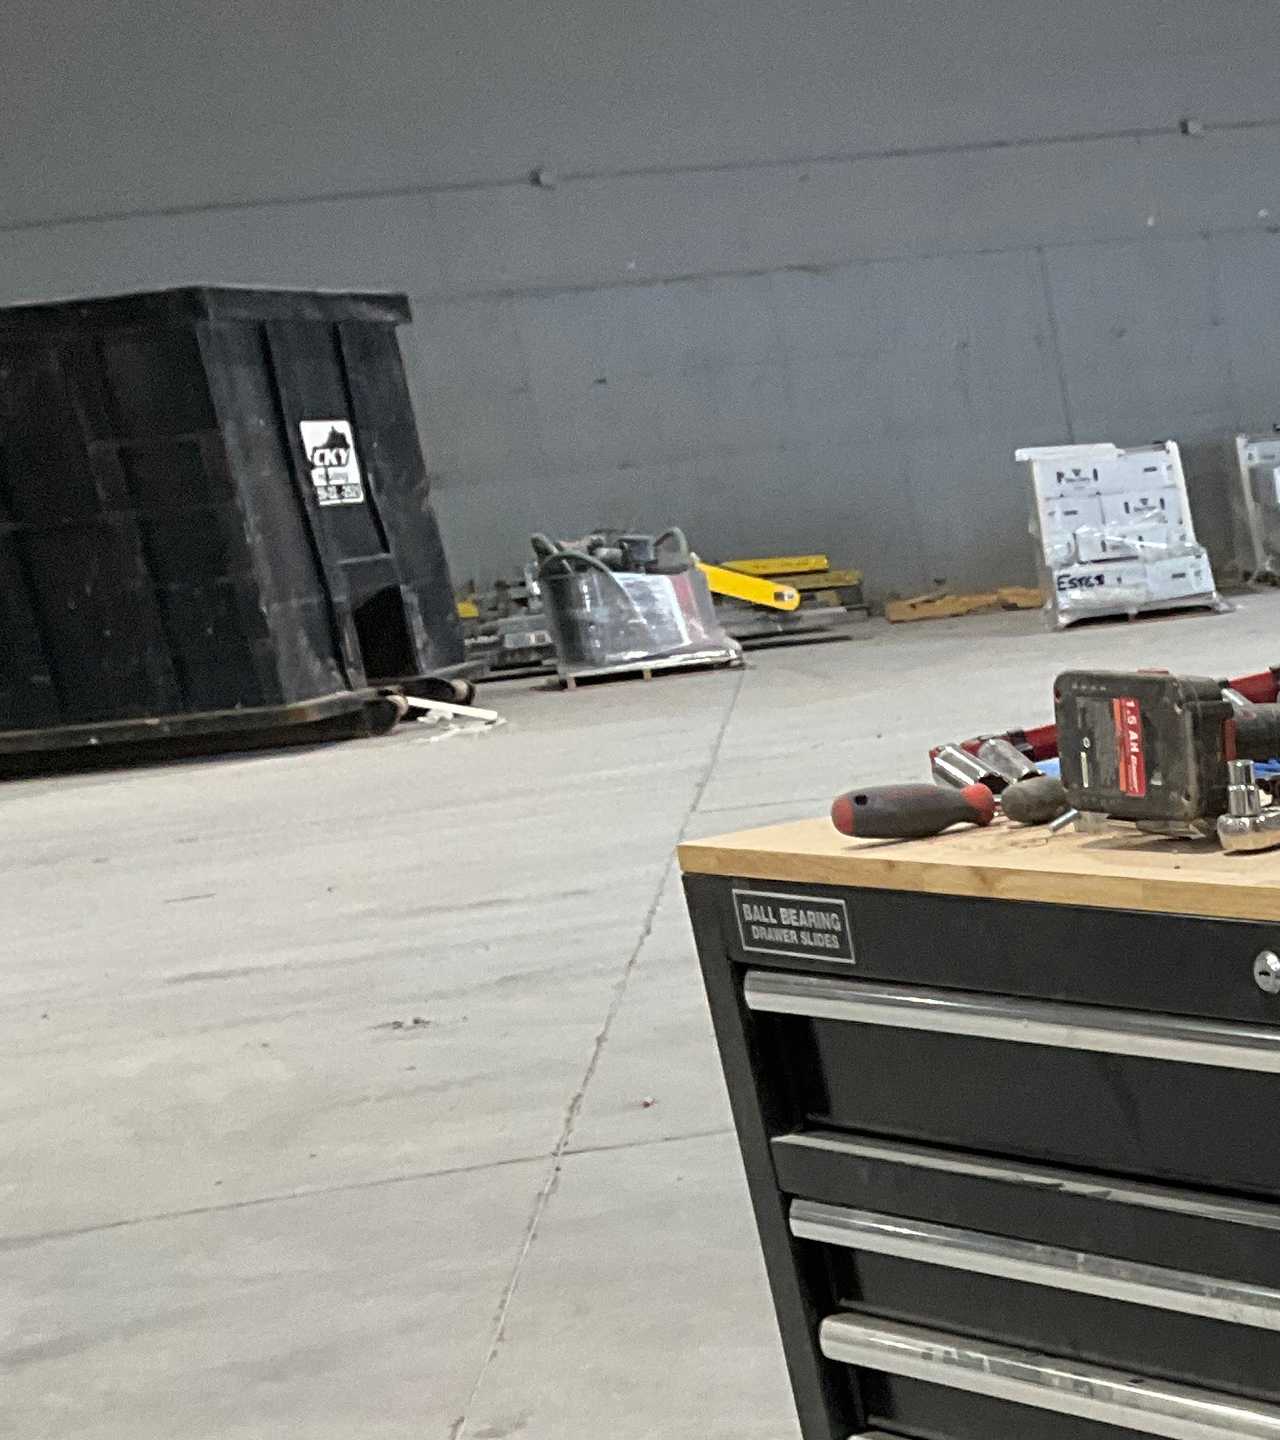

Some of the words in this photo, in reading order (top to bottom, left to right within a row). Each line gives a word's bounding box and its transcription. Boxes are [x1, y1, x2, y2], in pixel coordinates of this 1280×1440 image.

[742, 903, 778, 924] BALL
[779, 907, 842, 932] BEARING
[751, 925, 799, 945] DRAWER
[800, 931, 840, 949] SLIDES
